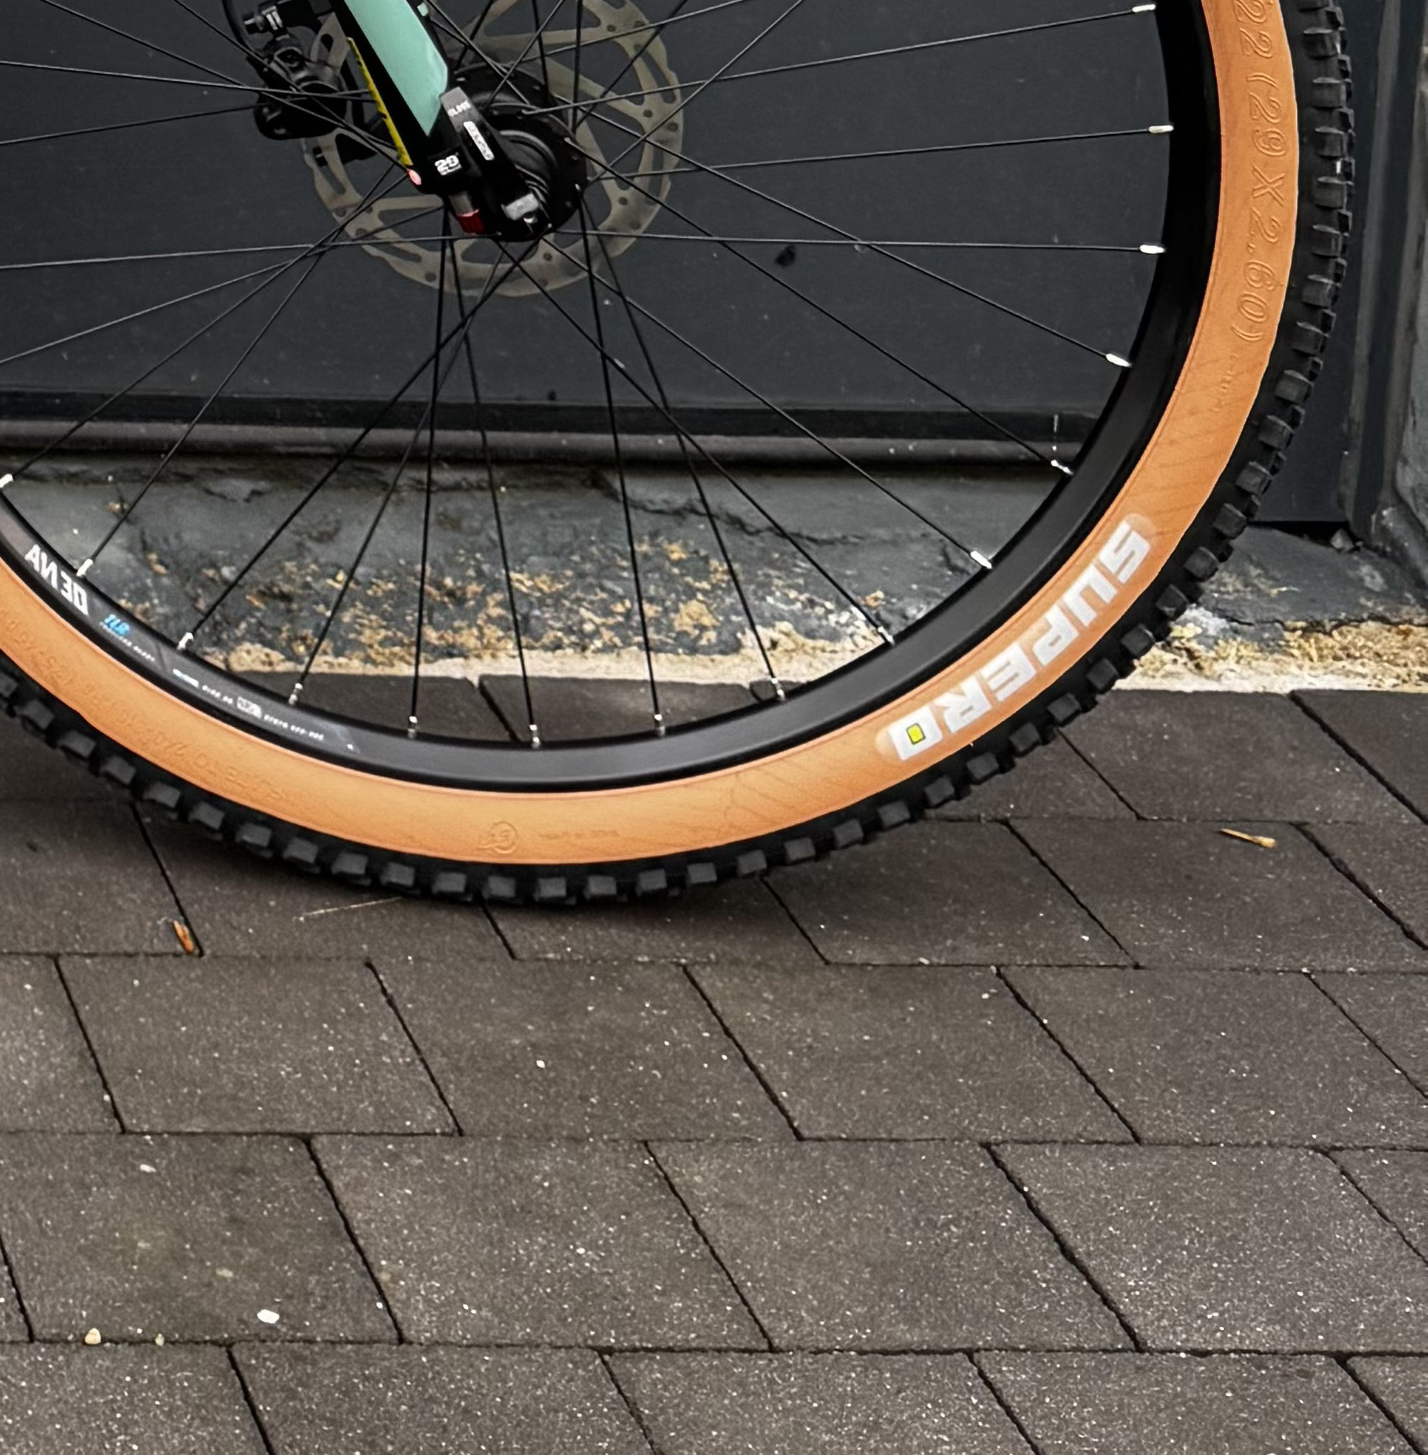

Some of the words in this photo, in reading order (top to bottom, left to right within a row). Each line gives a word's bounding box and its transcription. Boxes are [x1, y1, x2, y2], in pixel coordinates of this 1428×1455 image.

[1246, 72, 1286, 157] (29
[1252, 164, 1285, 207] X
[887, 519, 1151, 762] SUPERO
